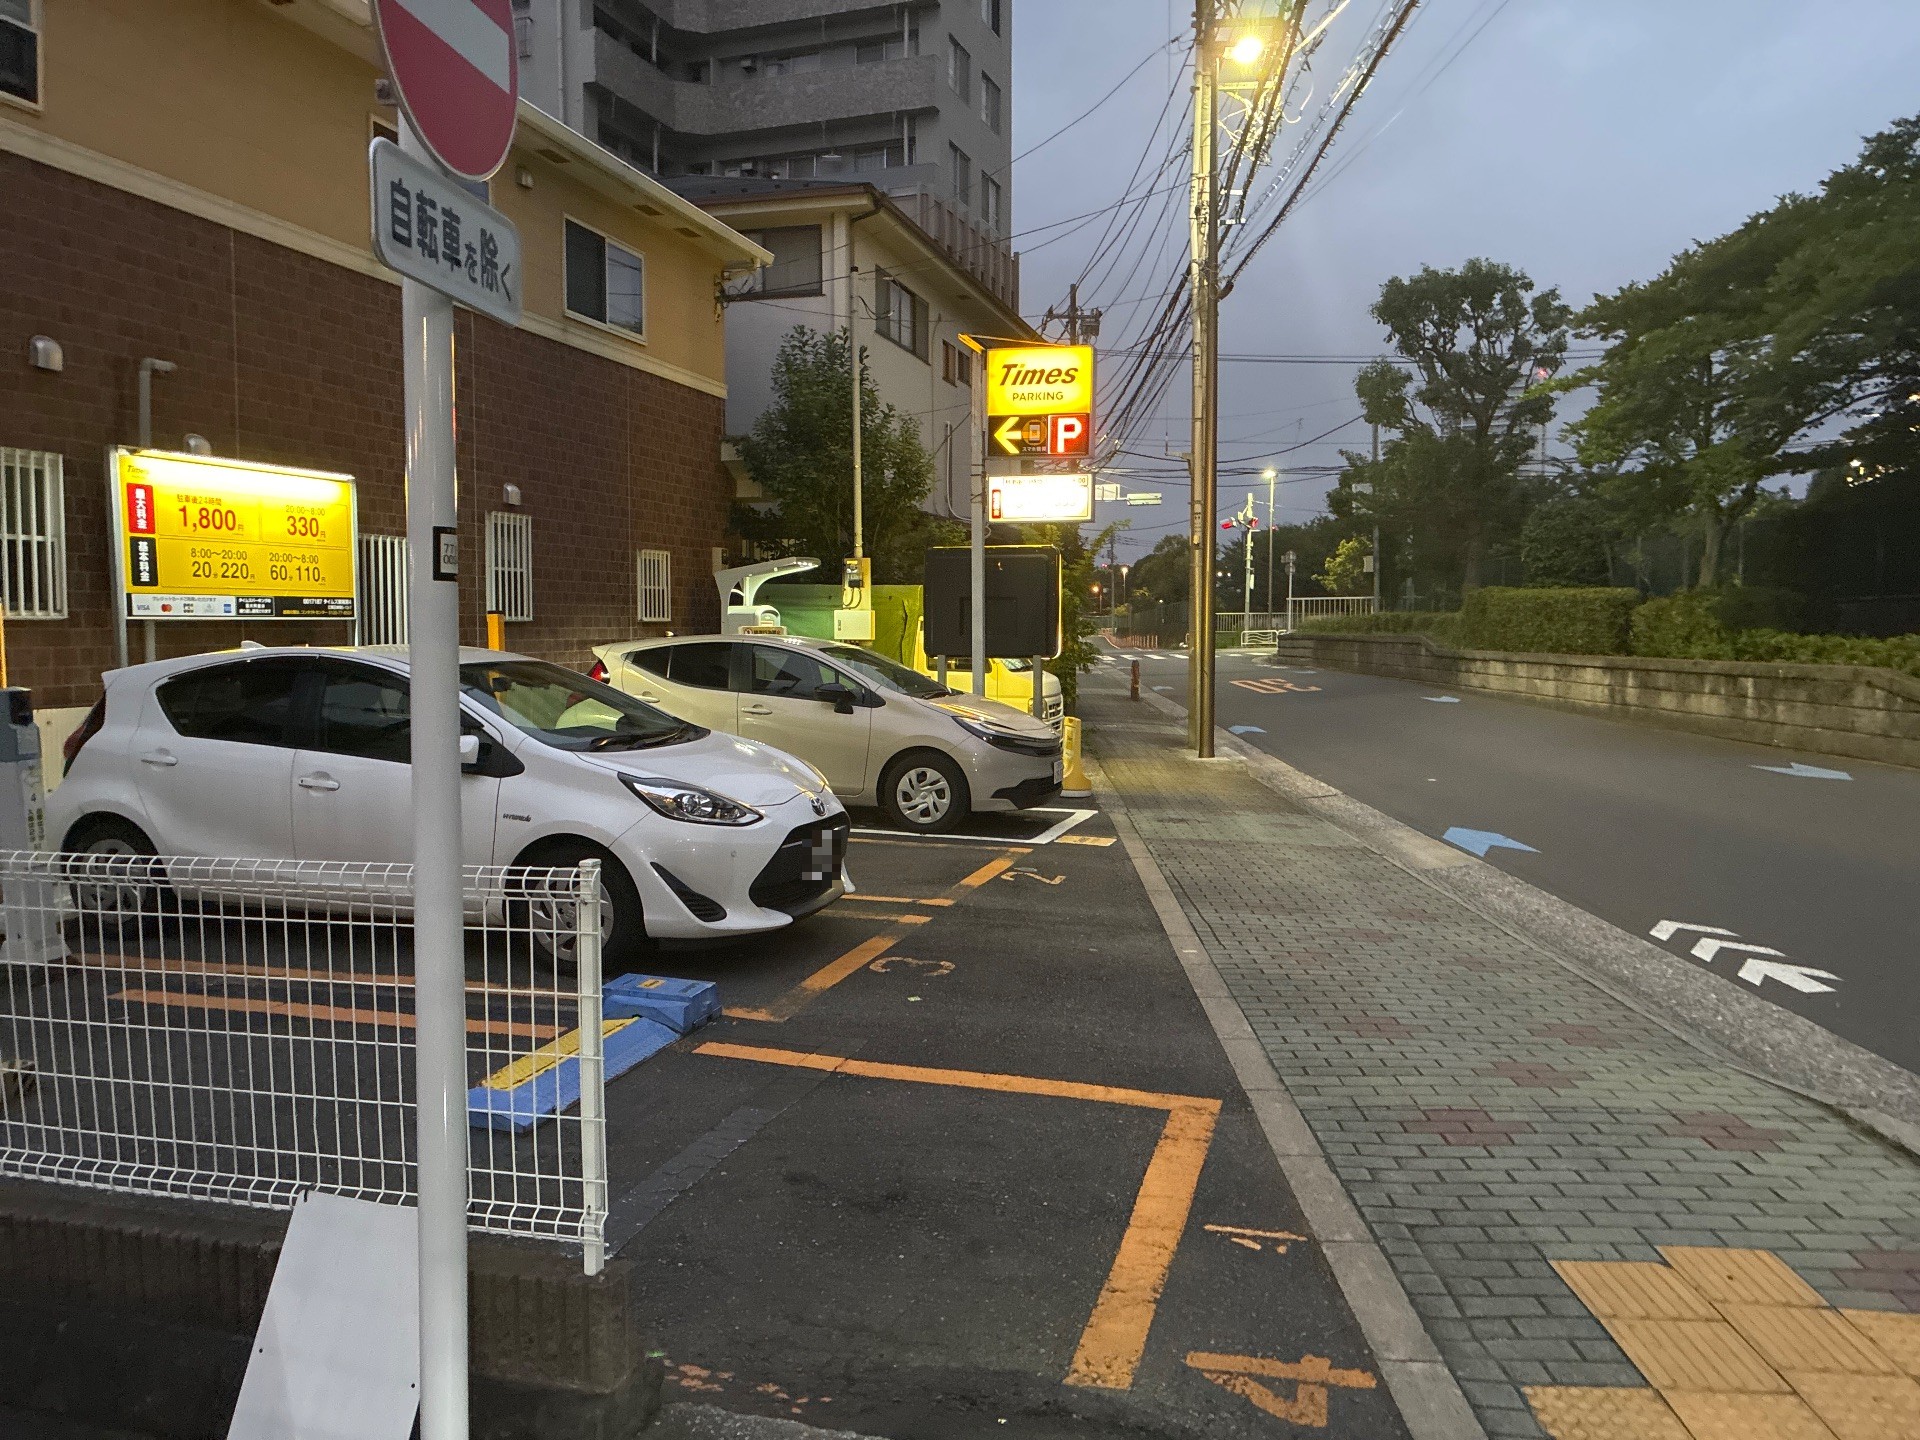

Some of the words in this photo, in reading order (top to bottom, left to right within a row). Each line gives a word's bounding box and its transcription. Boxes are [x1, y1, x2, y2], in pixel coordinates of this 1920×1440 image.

[391, 178, 511, 301] 自転車を除く
[1000, 363, 1079, 386] Times
[1012, 391, 1064, 401] PARKING
[1057, 417, 1082, 453] P
